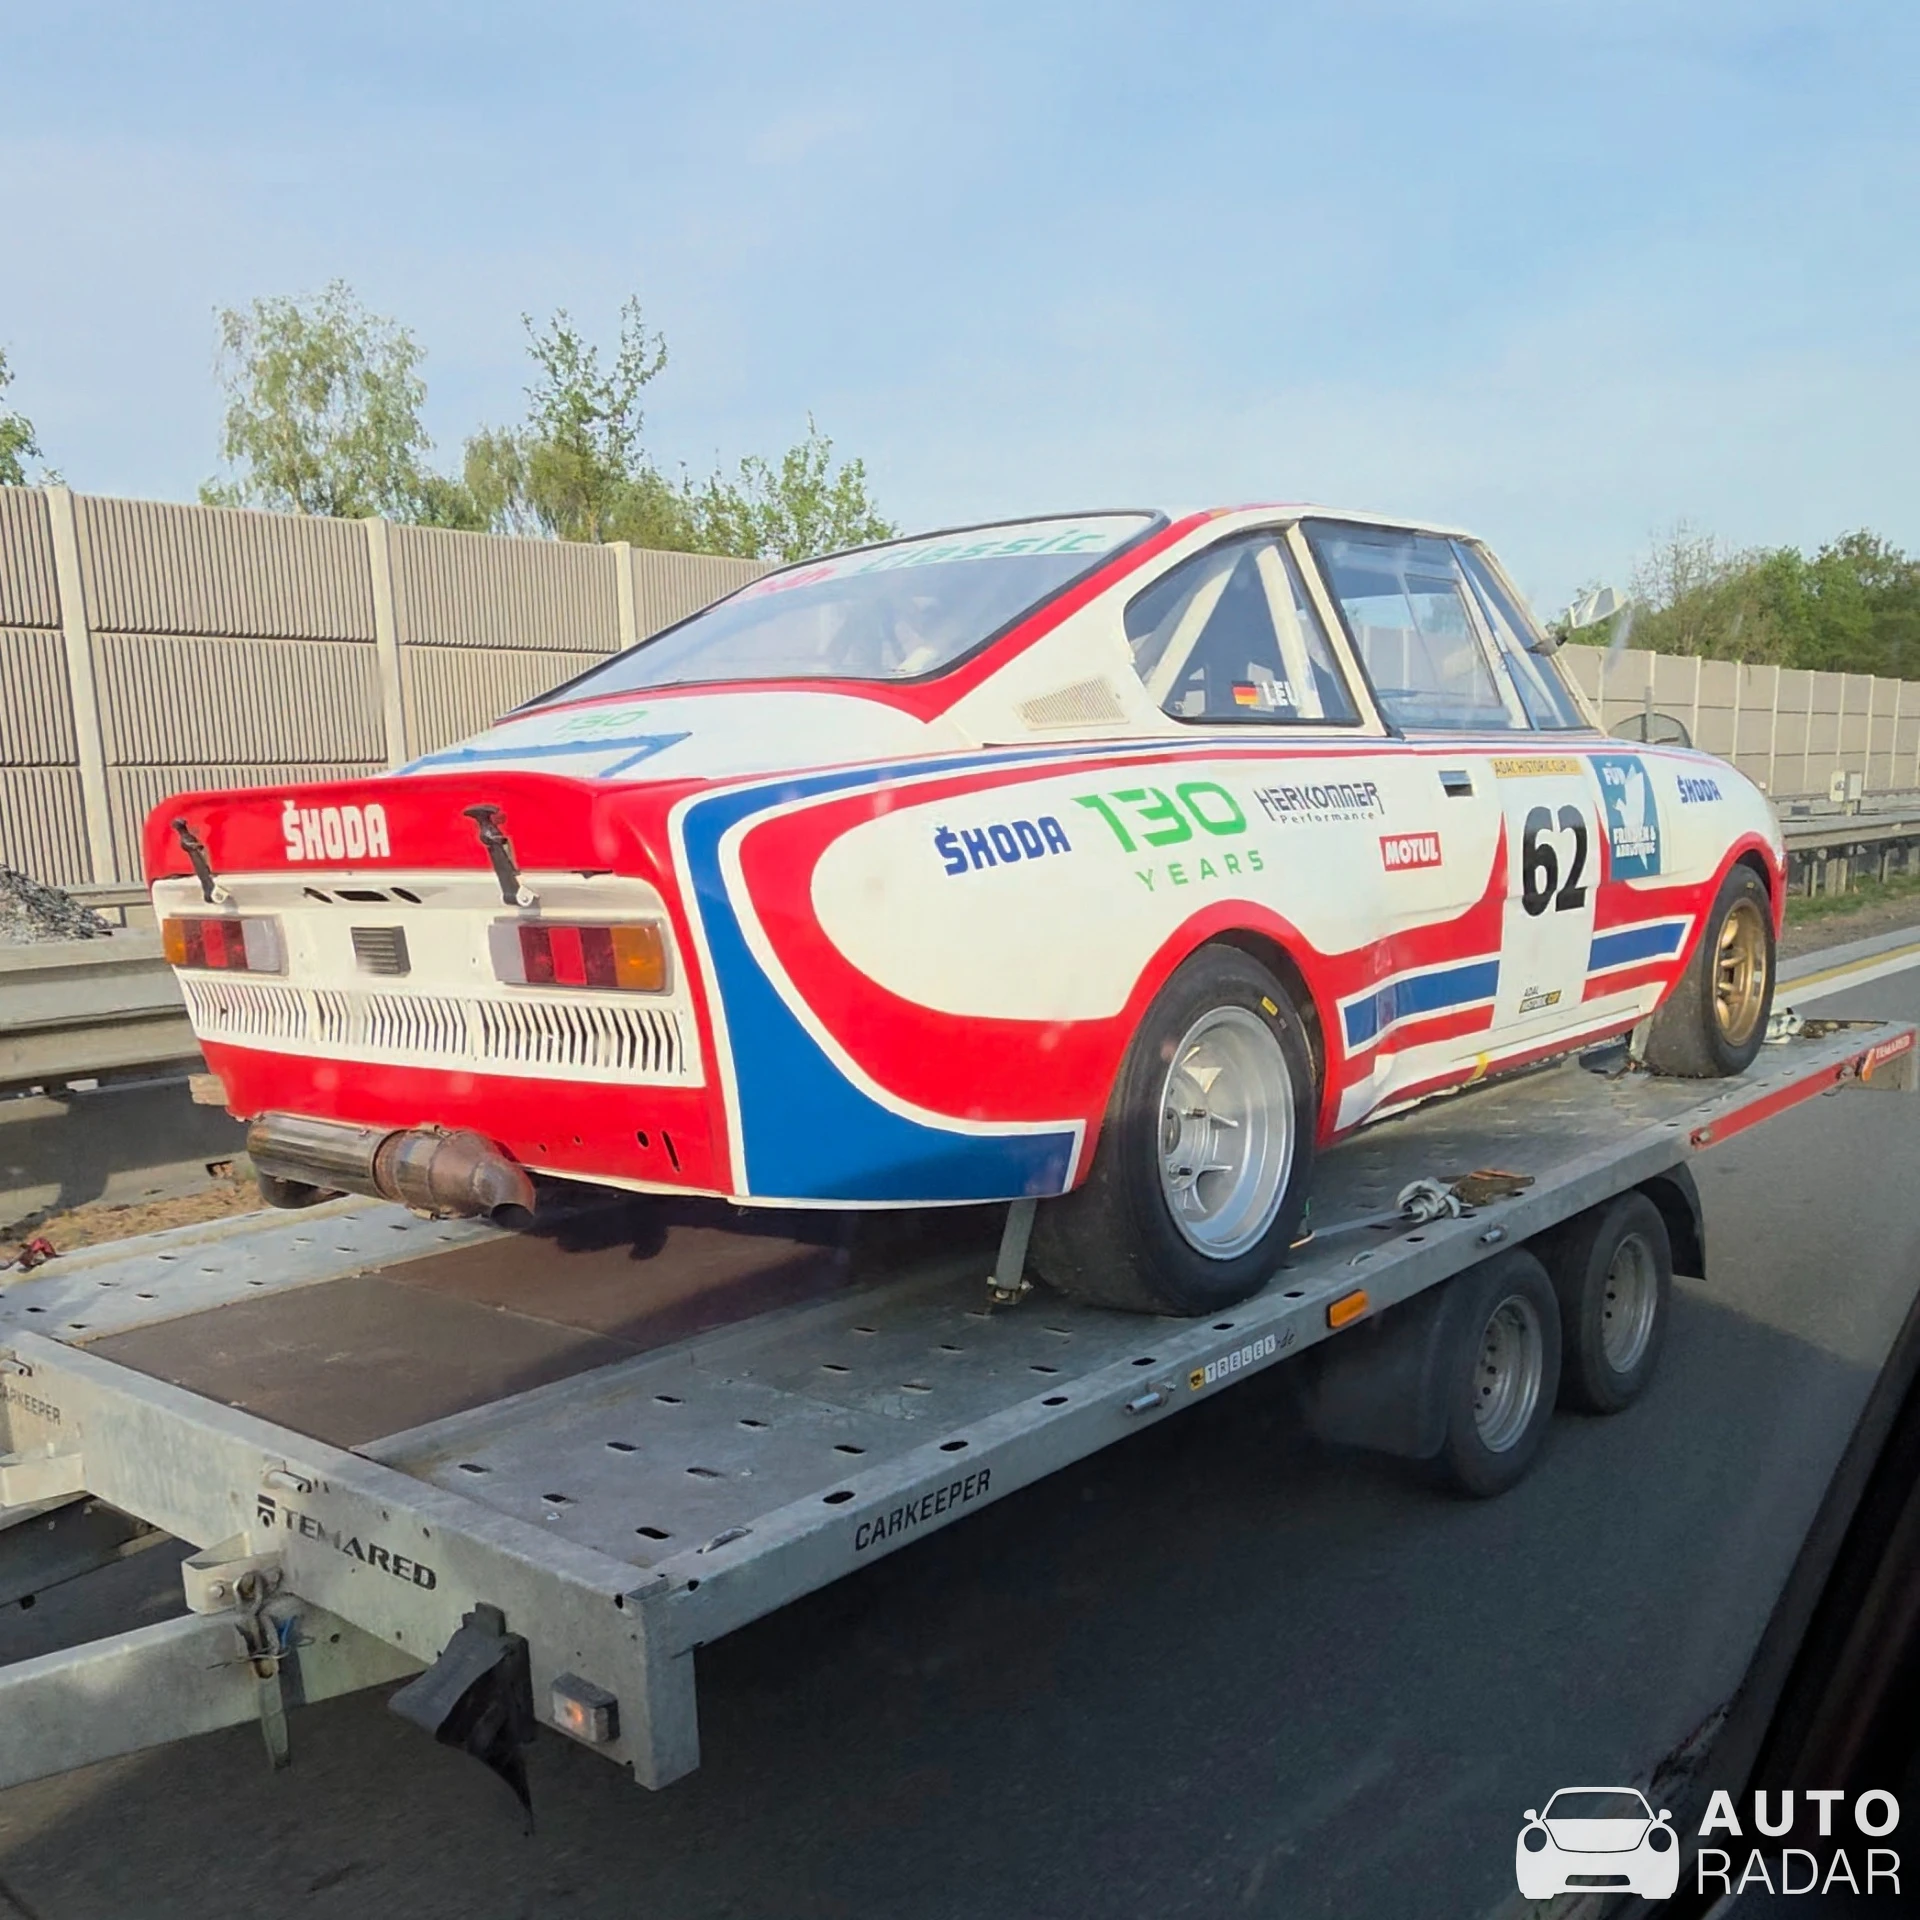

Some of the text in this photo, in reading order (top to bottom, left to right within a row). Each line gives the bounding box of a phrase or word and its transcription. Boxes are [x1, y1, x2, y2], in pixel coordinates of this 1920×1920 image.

[282, 801, 389, 860] ŠKODA
[1071, 782, 1247, 852] 130
[1254, 782, 1385, 821] HERKOMMER
[1280, 811, 1375, 824] Performance
[934, 816, 1072, 875] ŠKODA
[1135, 850, 1264, 892] YEARS
[1385, 838, 1438, 865] MOTUL
[1522, 804, 1587, 917] 62
[0, 1382, 61, 1425] ARKEEPER
[855, 1469, 991, 1550] CARKEEPER
[281, 1507, 437, 1591] TEMARED
